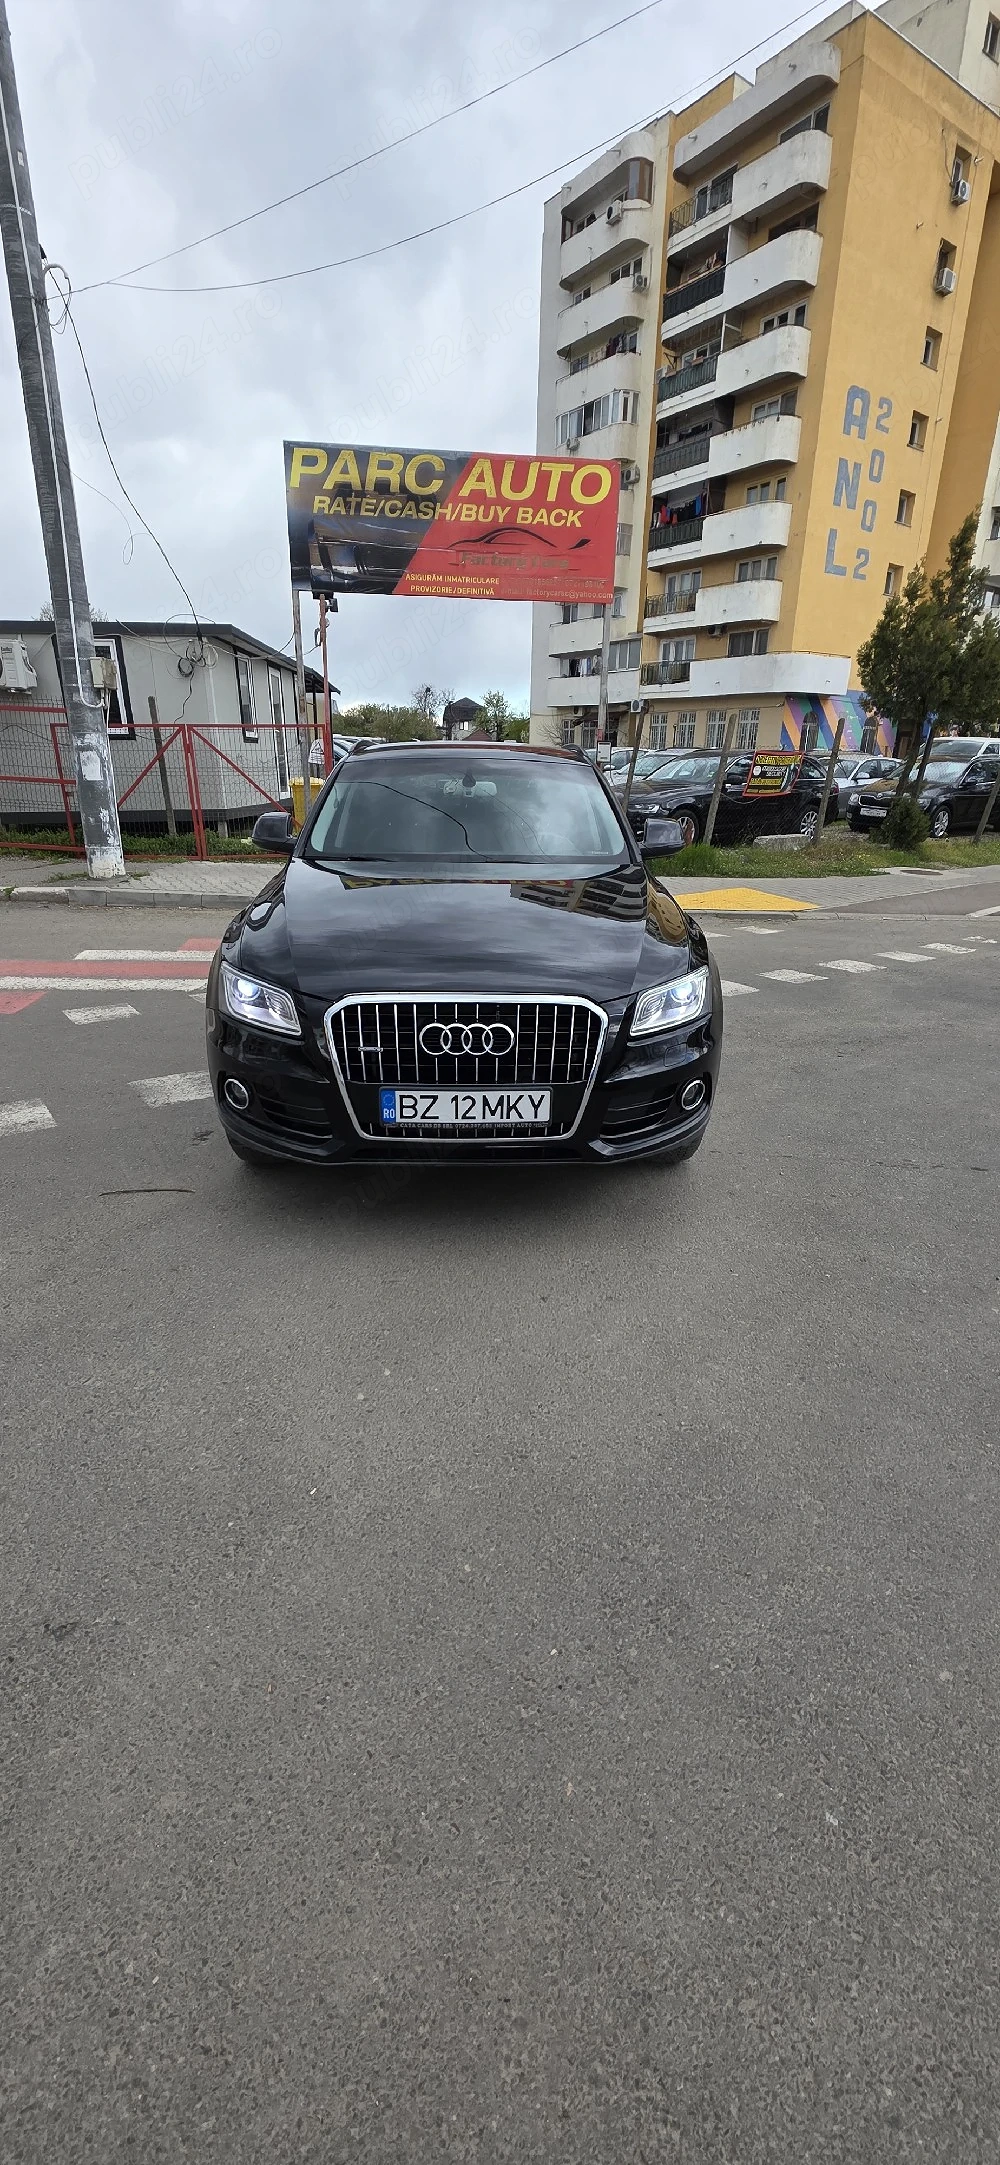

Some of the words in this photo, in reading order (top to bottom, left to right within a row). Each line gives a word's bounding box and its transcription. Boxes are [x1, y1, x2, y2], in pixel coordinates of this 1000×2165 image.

[289, 447, 446, 496] PARC
[458, 458, 612, 505] AUTO
[312, 495, 512, 523] RATE/CASH/BUY
[516, 507, 584, 528] BACK
[444, 576, 500, 585] INMATRICULARE
[383, 1108, 395, 1119] RO
[399, 1094, 439, 1119] BZ
[450, 1094, 477, 1119] 12
[482, 1094, 546, 1119] MKY
